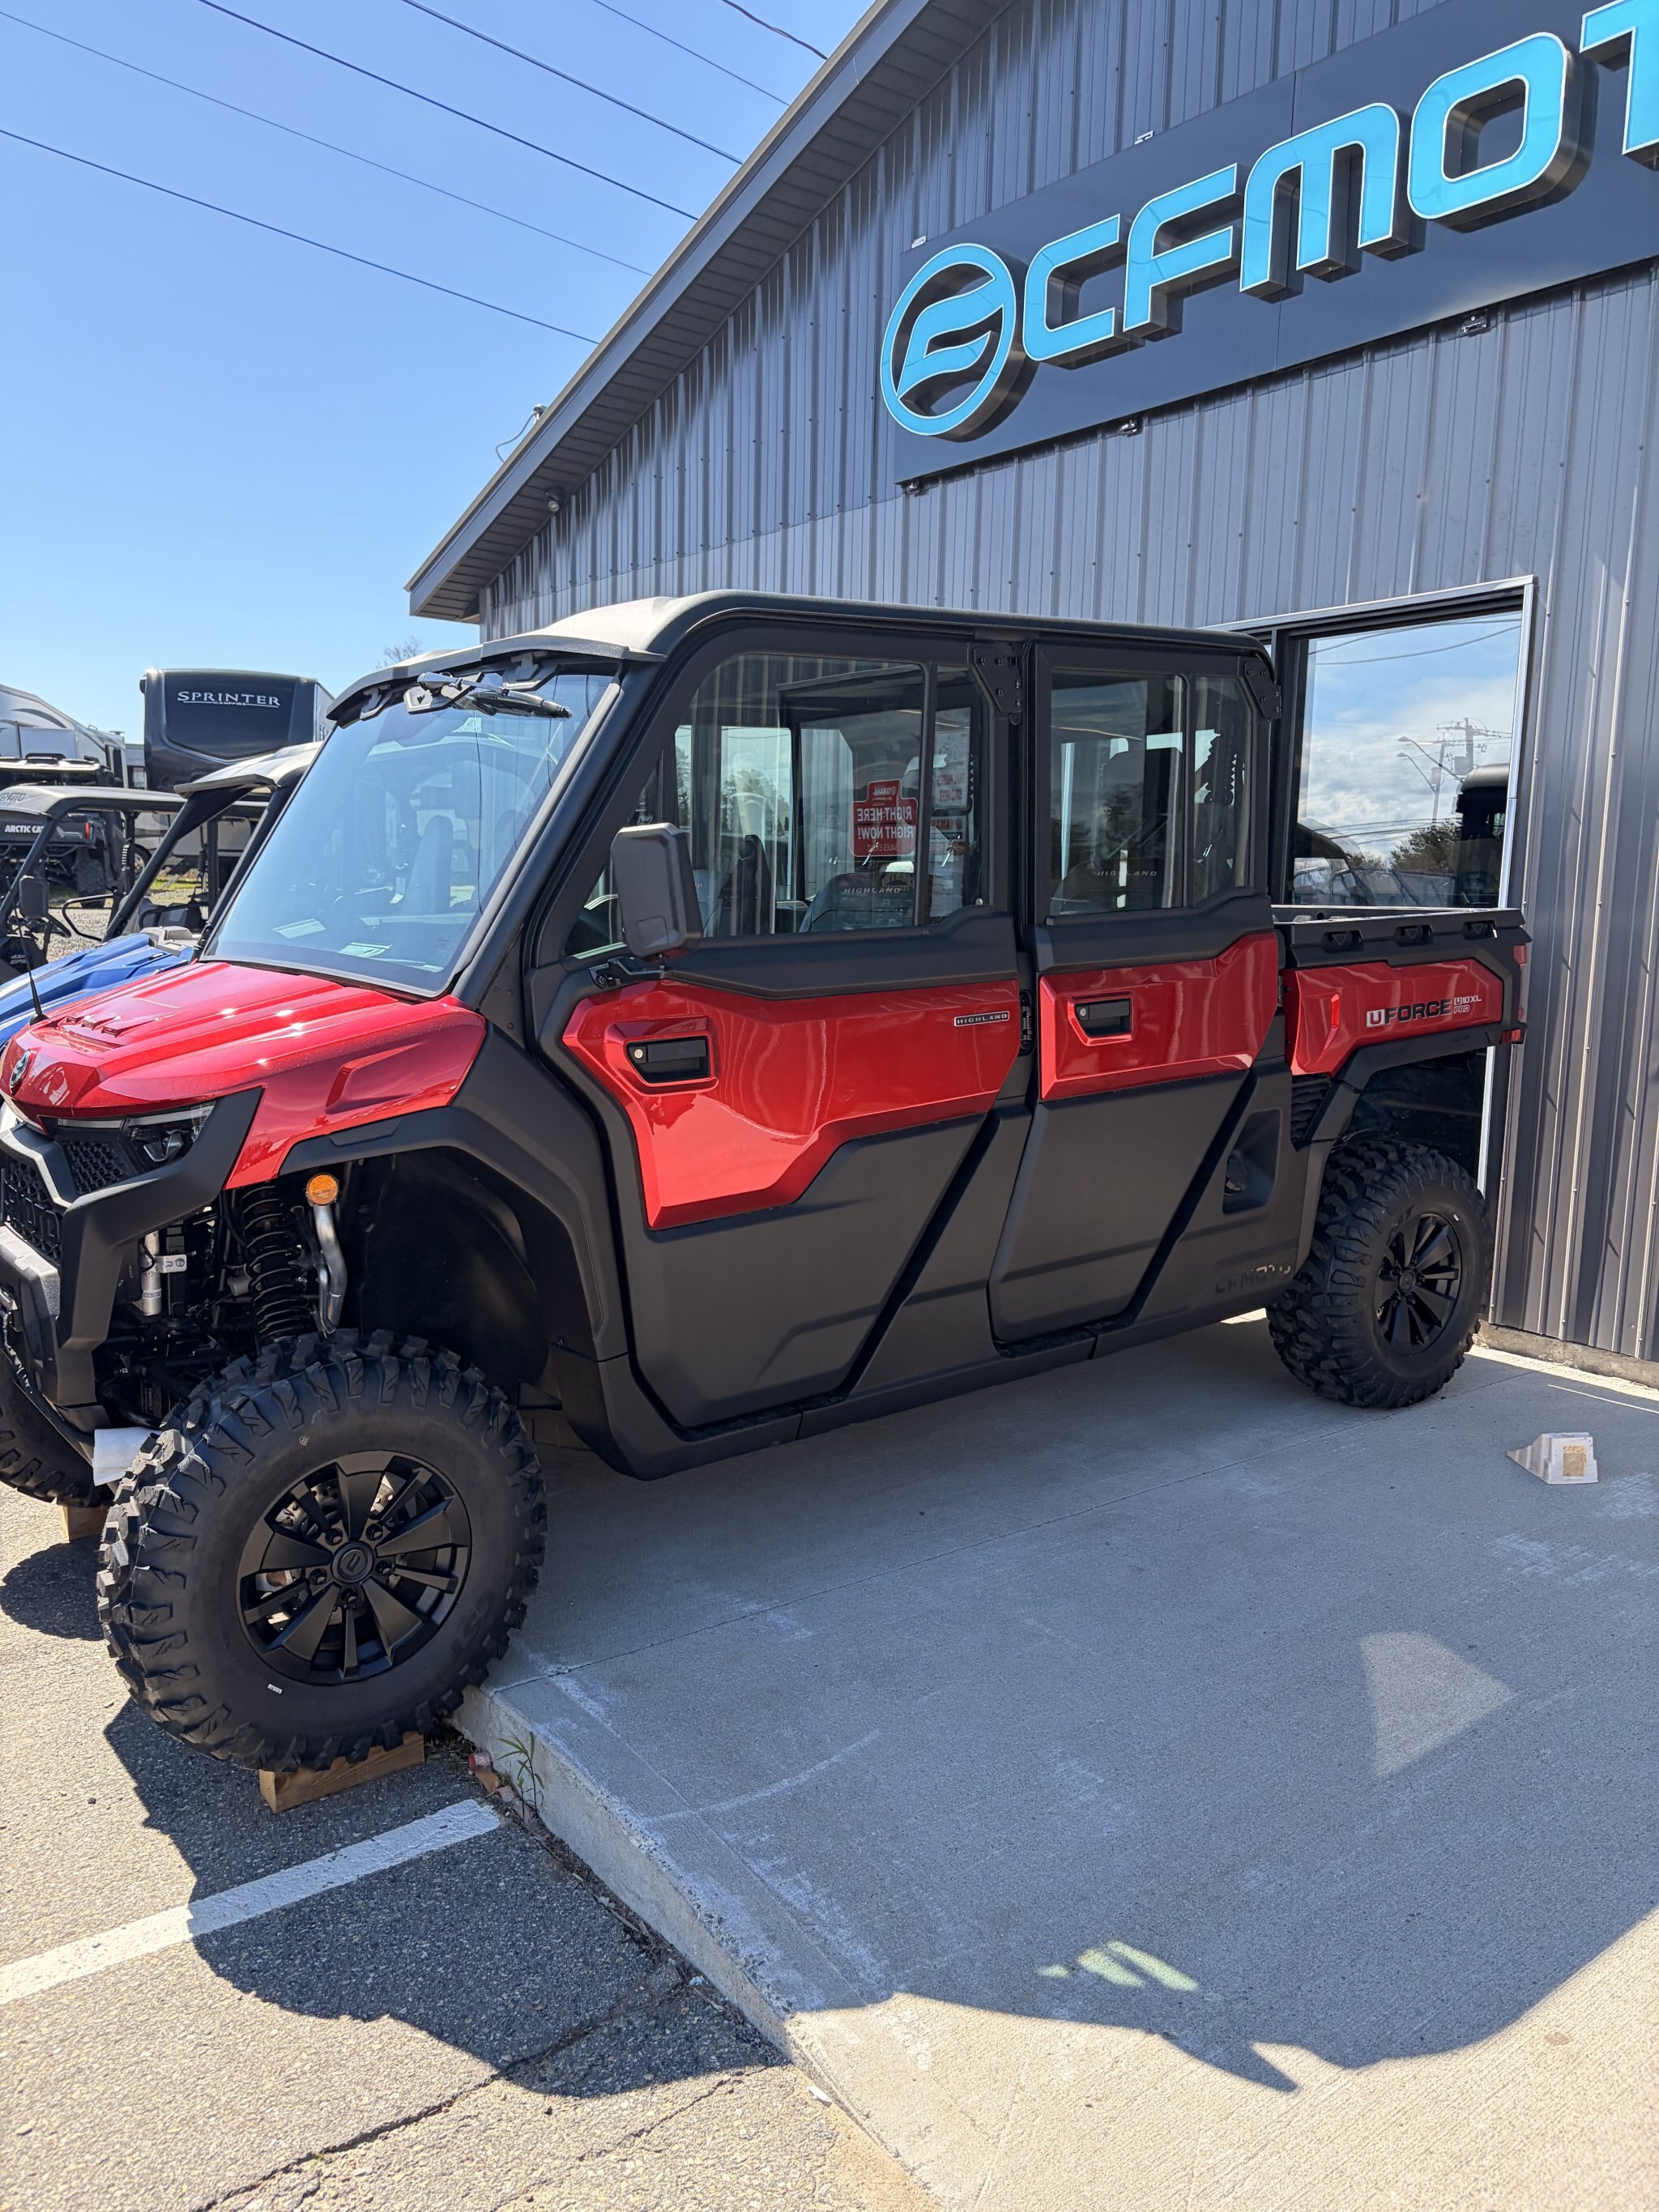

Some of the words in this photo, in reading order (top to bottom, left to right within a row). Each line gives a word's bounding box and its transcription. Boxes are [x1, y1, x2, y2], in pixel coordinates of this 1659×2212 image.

[177, 691, 280, 706] SPRINTER
[5, 825, 31, 833] ARCTIC
[1454, 1004, 1469, 1013] PRO
[957, 1013, 1008, 1024] HIGHLAND
